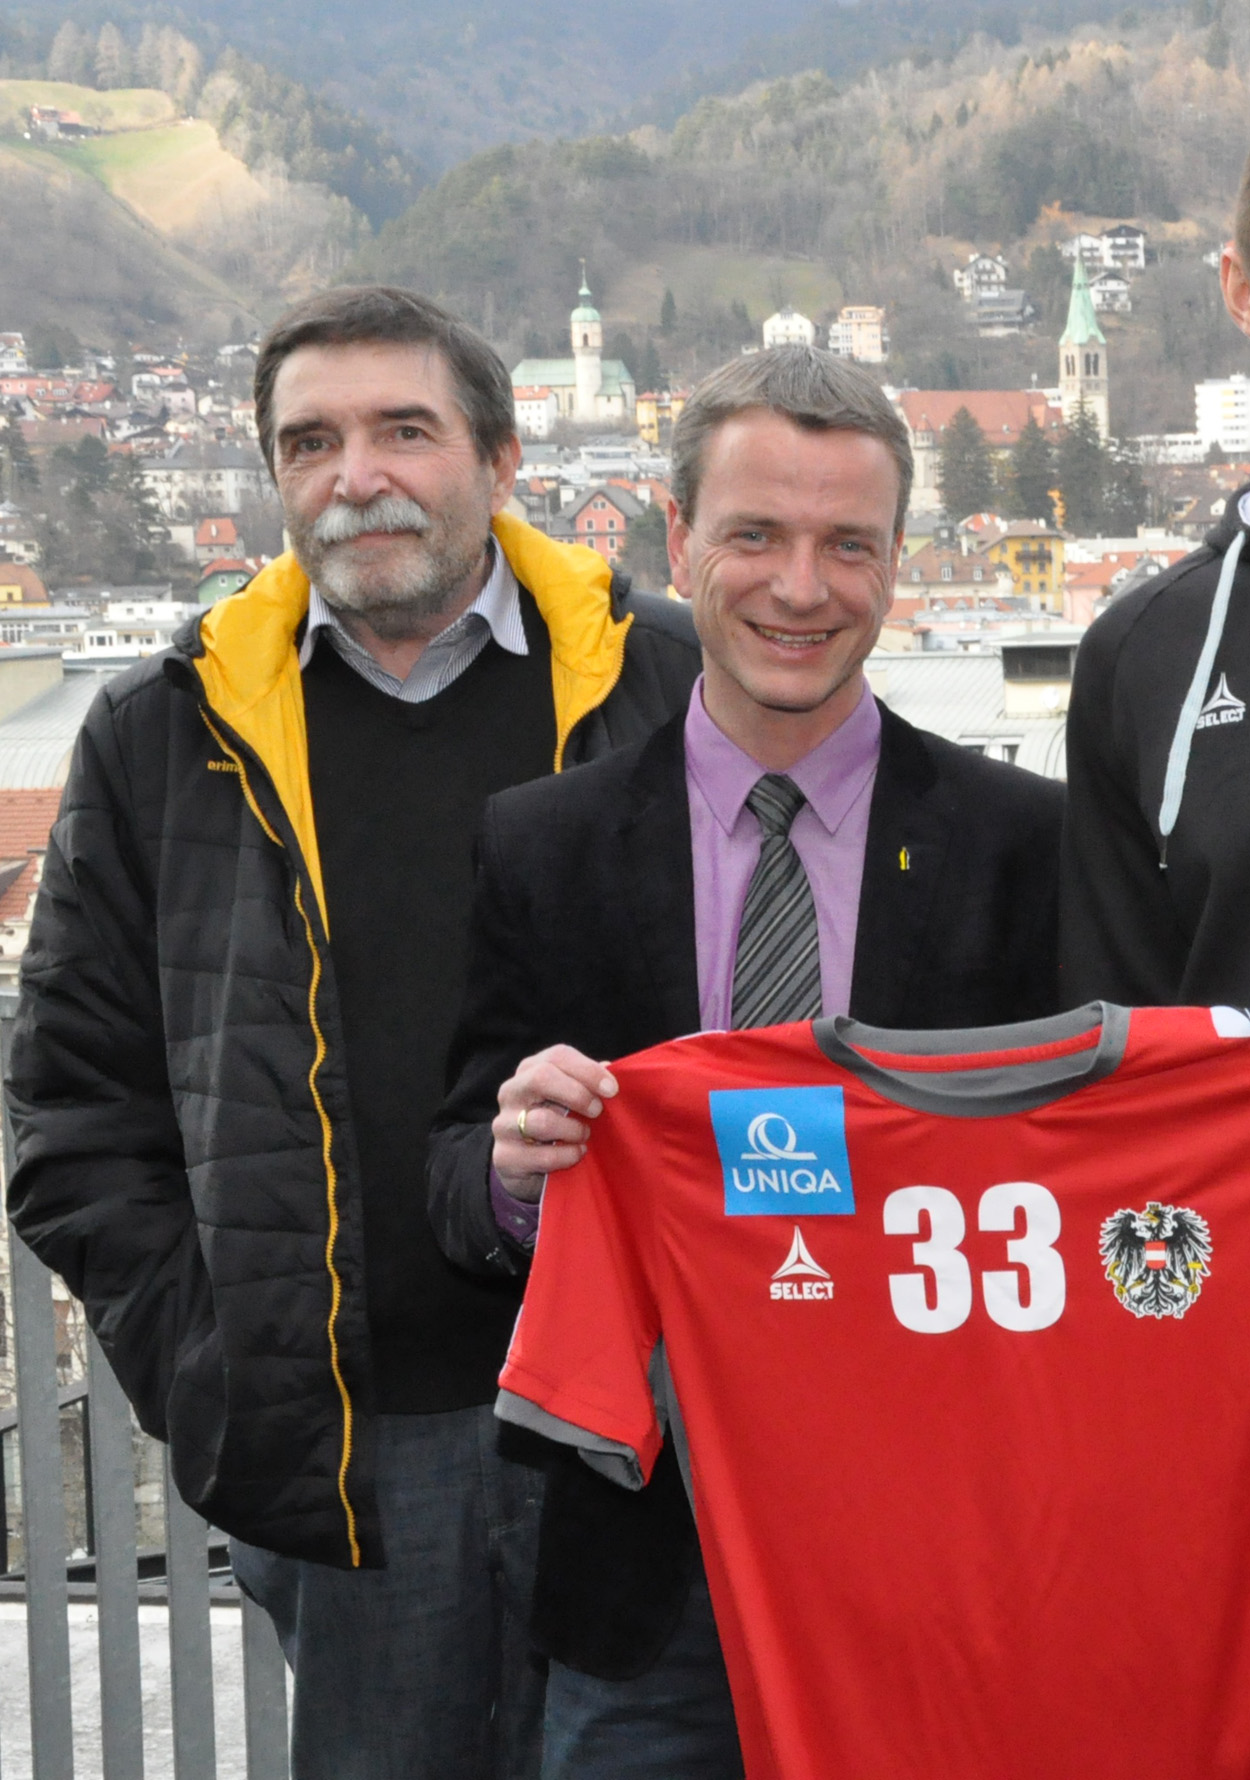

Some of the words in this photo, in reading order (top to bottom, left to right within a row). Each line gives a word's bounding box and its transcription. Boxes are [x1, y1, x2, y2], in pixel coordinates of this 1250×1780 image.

[1196, 707, 1246, 730] SELECT
[207, 760, 241, 773] erim
[732, 1167, 842, 1194] UNIQA
[882, 1181, 1067, 1334] 33
[769, 1281, 834, 1300] SELECT
